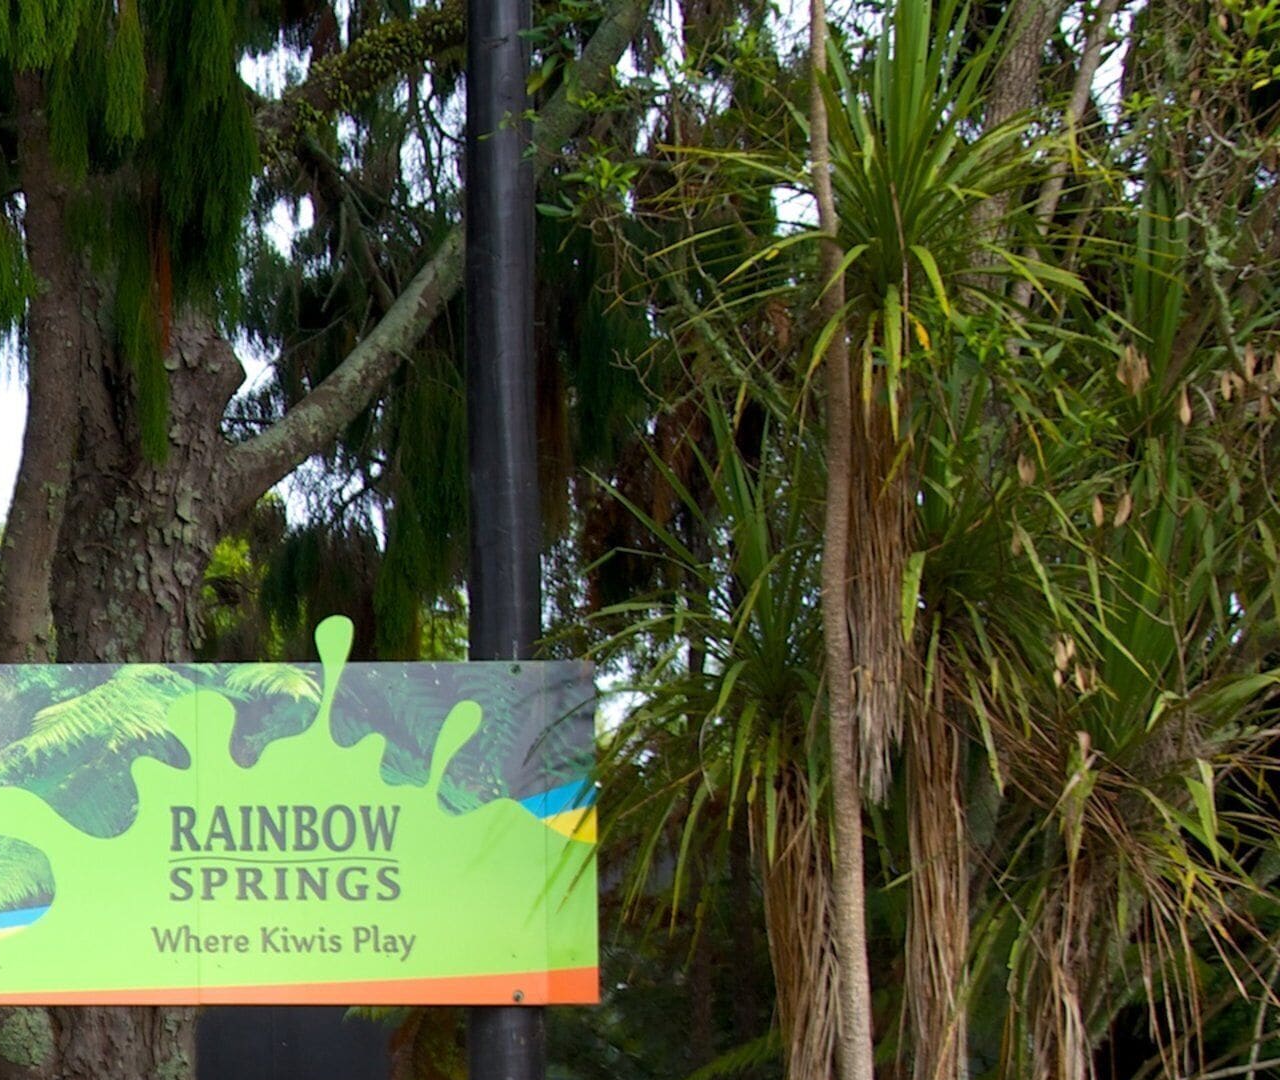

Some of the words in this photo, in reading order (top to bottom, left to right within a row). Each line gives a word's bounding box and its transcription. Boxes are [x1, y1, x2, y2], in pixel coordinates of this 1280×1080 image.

[169, 804, 401, 853] RAINBOW
[169, 866, 402, 902] SPRINGS
[151, 926, 251, 955] Where
[261, 926, 342, 955] Kiwis
[352, 926, 417, 963] Play
